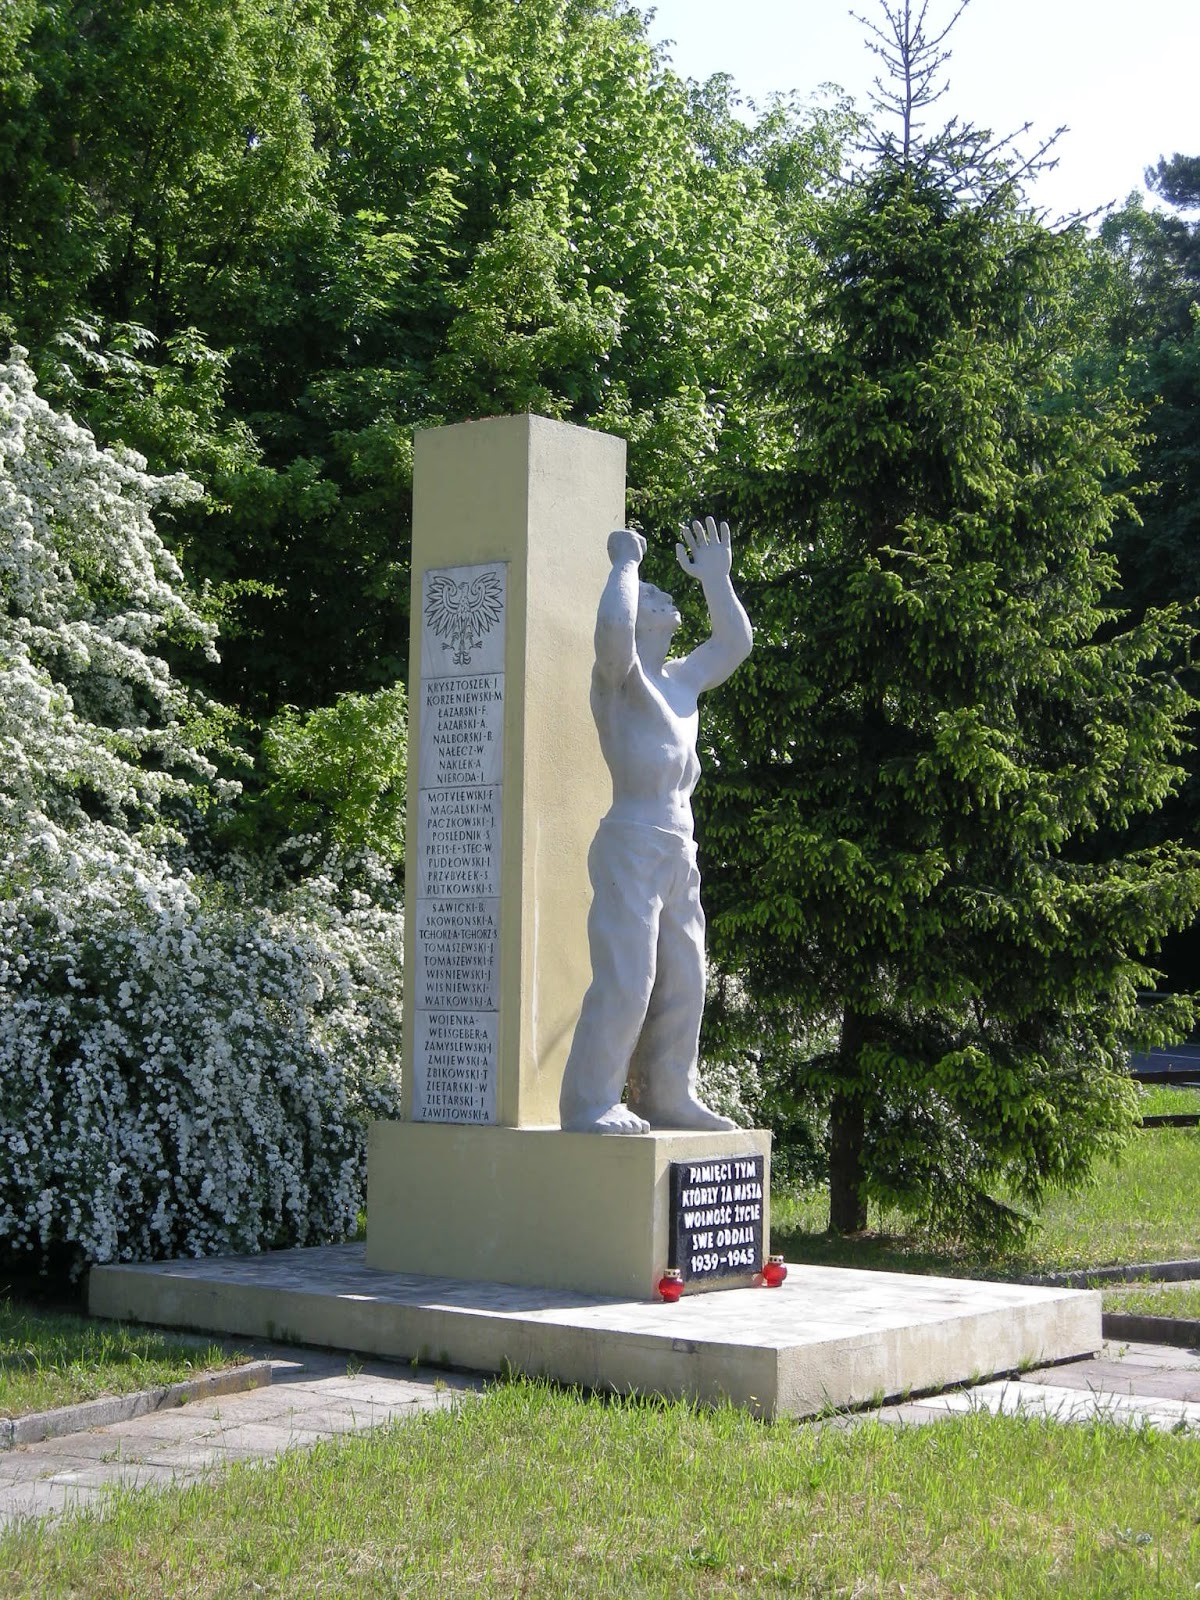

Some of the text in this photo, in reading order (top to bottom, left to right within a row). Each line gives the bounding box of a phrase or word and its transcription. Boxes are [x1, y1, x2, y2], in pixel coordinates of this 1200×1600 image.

[689, 1161, 756, 1183] PAMIĘCI TYM
[682, 1187, 719, 1208] KTÓRZY
[721, 1185, 733, 1203] ZA
[684, 1204, 760, 1229] WOLNOŚĆ ŻYCIE
[692, 1226, 755, 1251] SWE ODDALI
